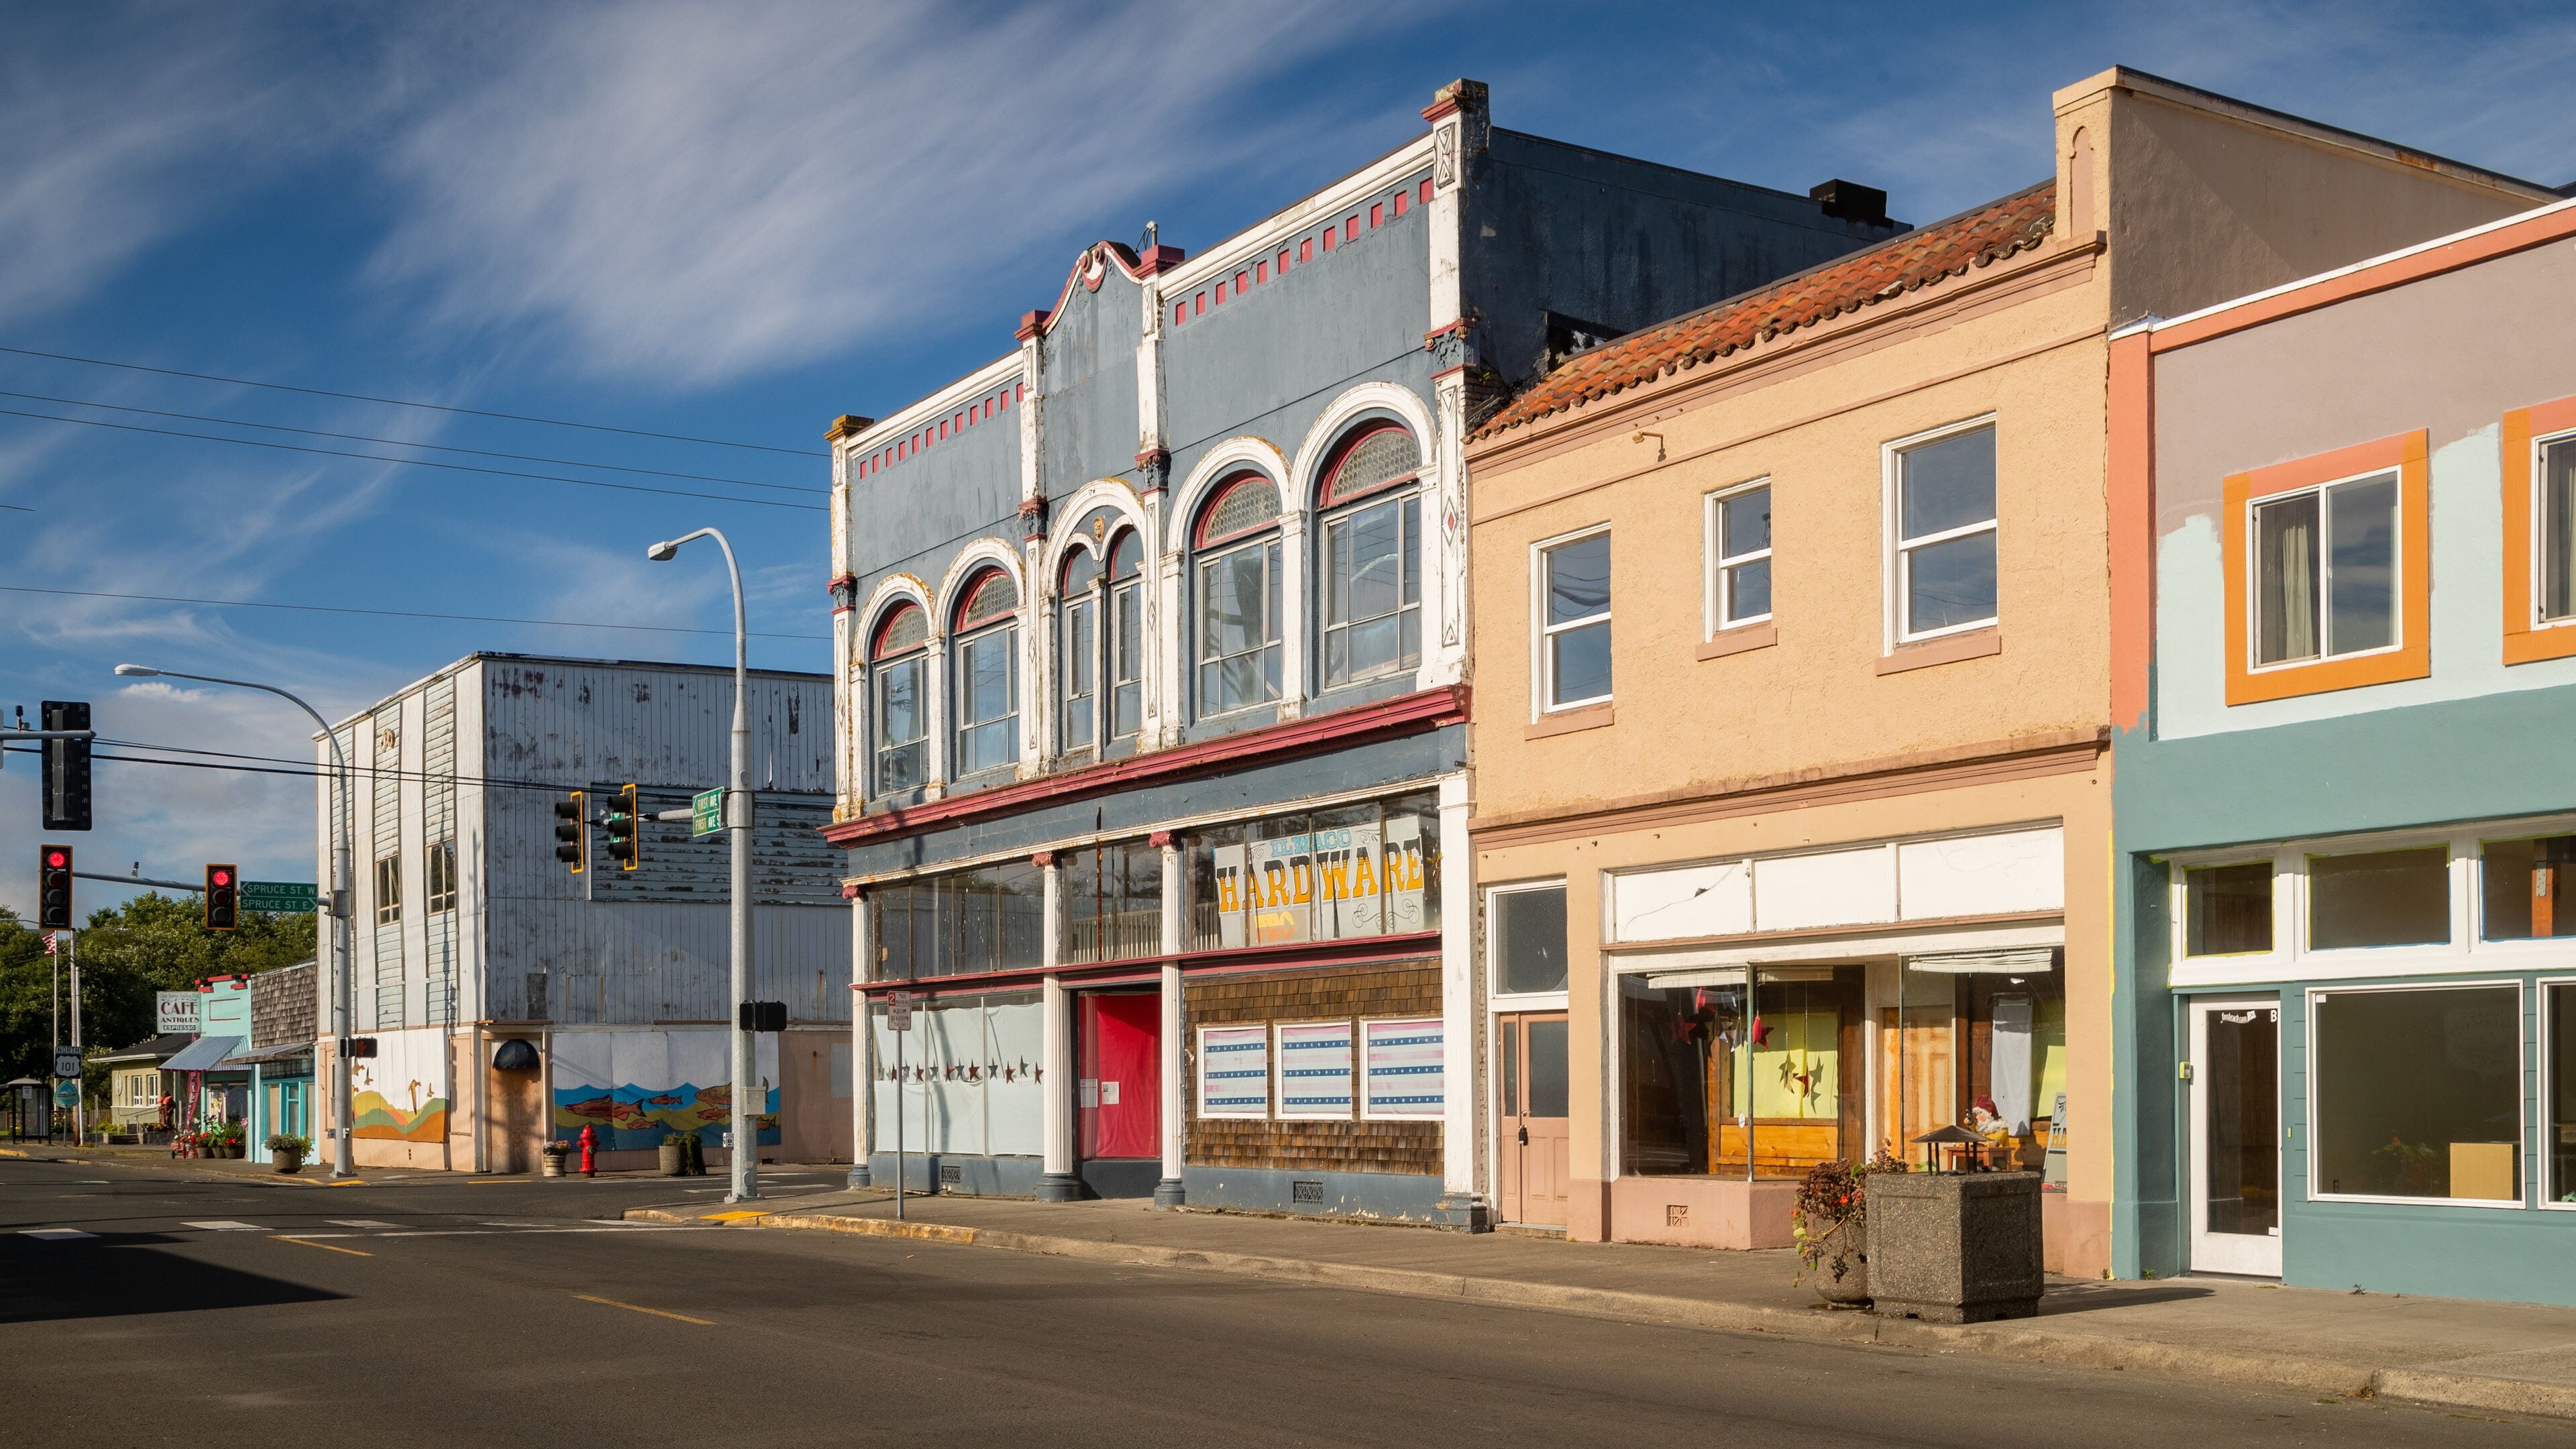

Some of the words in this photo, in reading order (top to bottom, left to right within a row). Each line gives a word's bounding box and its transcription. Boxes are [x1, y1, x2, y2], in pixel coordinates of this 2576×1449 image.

[698, 797, 708, 810] FIRST
[695, 818, 706, 831] FIRST
[1270, 828, 1352, 857] ILWACO
[1216, 835, 1424, 913] HARDWARE
[247, 885, 286, 894] SPRUCE
[290, 885, 303, 895] ST.
[307, 886, 317, 895] W.
[242, 900, 280, 909] SPRUCE
[285, 900, 299, 909] ST.
[890, 994, 895, 1004] 2
[160, 1002, 199, 1014] CAFE
[2270, 1010, 2277, 1022] B
[62, 1062, 74, 1071] 101
